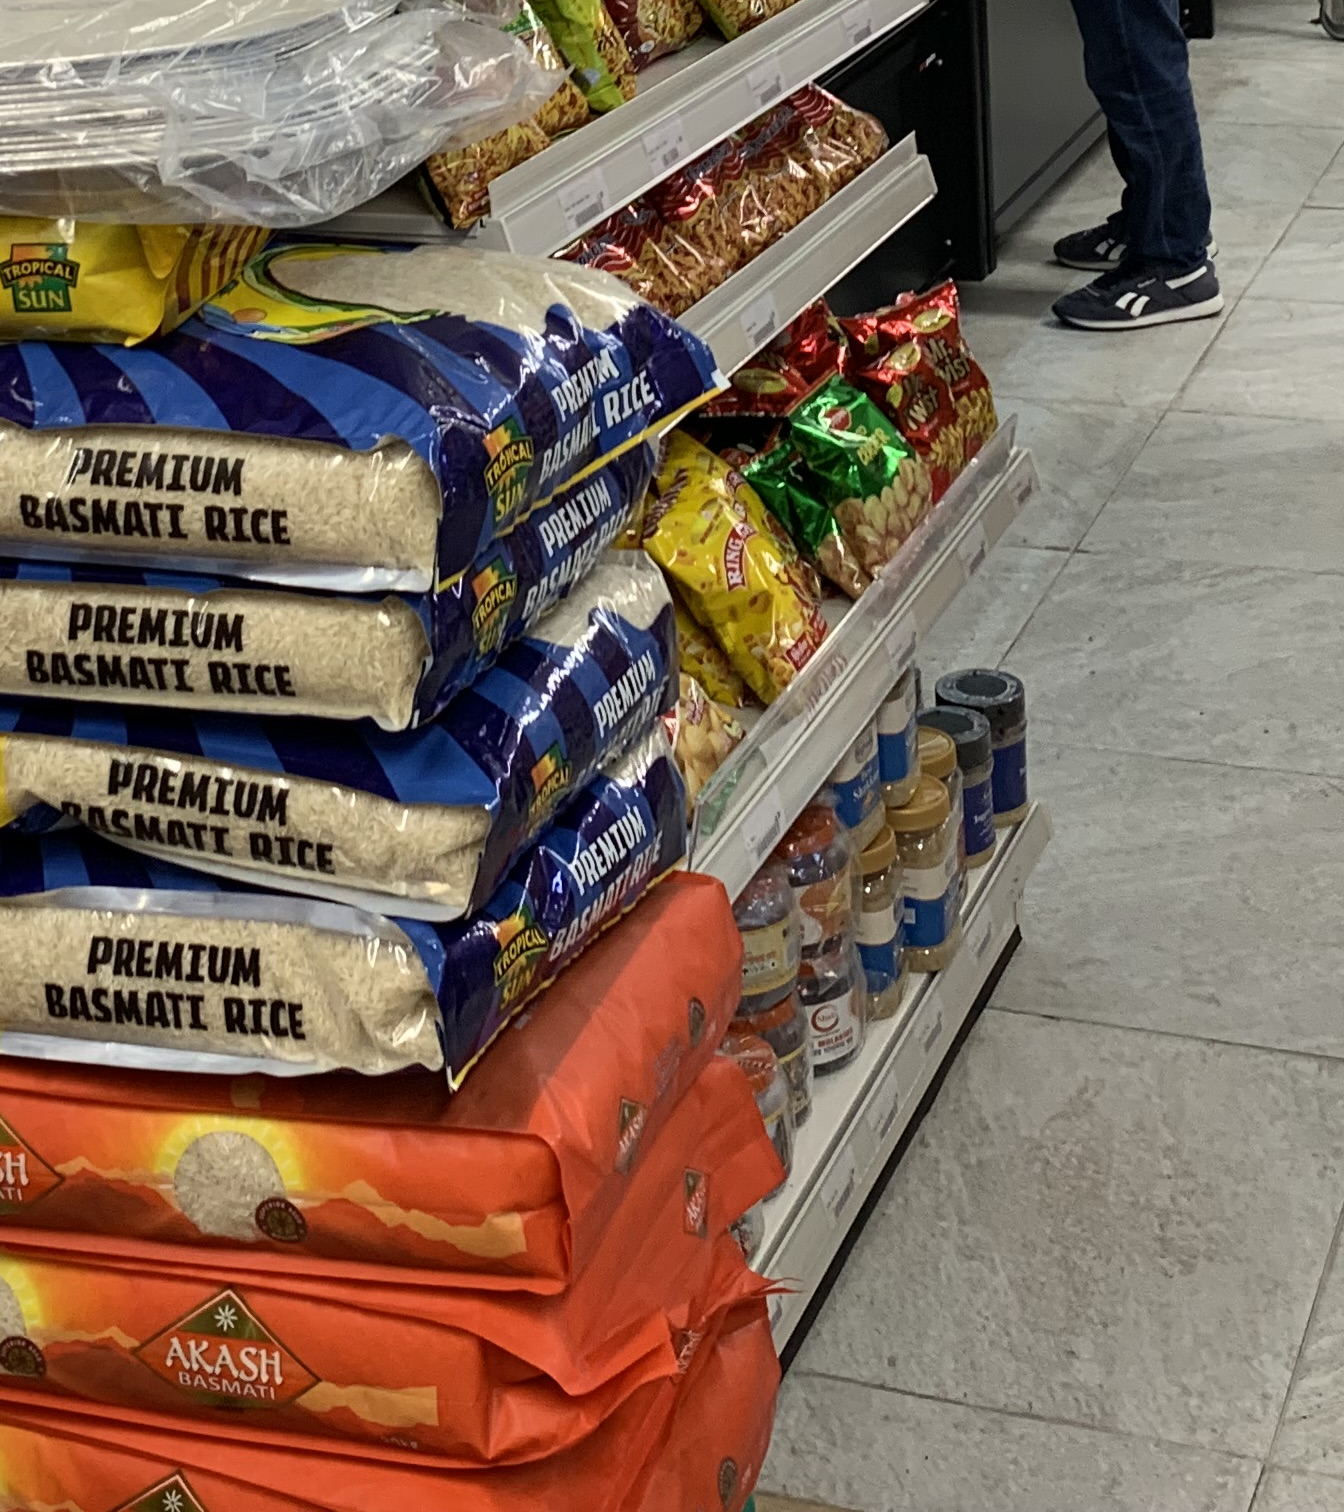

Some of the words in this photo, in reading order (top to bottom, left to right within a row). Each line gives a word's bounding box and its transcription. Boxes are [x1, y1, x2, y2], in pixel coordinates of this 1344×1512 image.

[1, 259, 75, 283] TROPICAL
[17, 288, 66, 311] SUN
[550, 348, 621, 425] PREMIUM
[600, 367, 658, 428] RICE
[68, 446, 245, 496] PREMIUM
[18, 493, 184, 540] BASMATI
[204, 506, 291, 546] RICE
[537, 476, 613, 558] PREMIUM
[67, 602, 245, 653] PREMIUM
[26, 649, 194, 693] BASMATI
[207, 660, 297, 698] RICE
[592, 651, 658, 736] PREMIUM
[106, 758, 291, 828] PREMIUM
[60, 799, 234, 858] BASMATI
[248, 830, 337, 876] RICE
[570, 805, 649, 897] PREMIUM
[87, 935, 261, 989] PREMIUM
[494, 922, 552, 976] TROPICAL
[44, 983, 210, 1032] BASMATI
[224, 996, 307, 1041] RICE
[164, 1336, 285, 1387] AKASH
[177, 1370, 277, 1401] BASMATI
